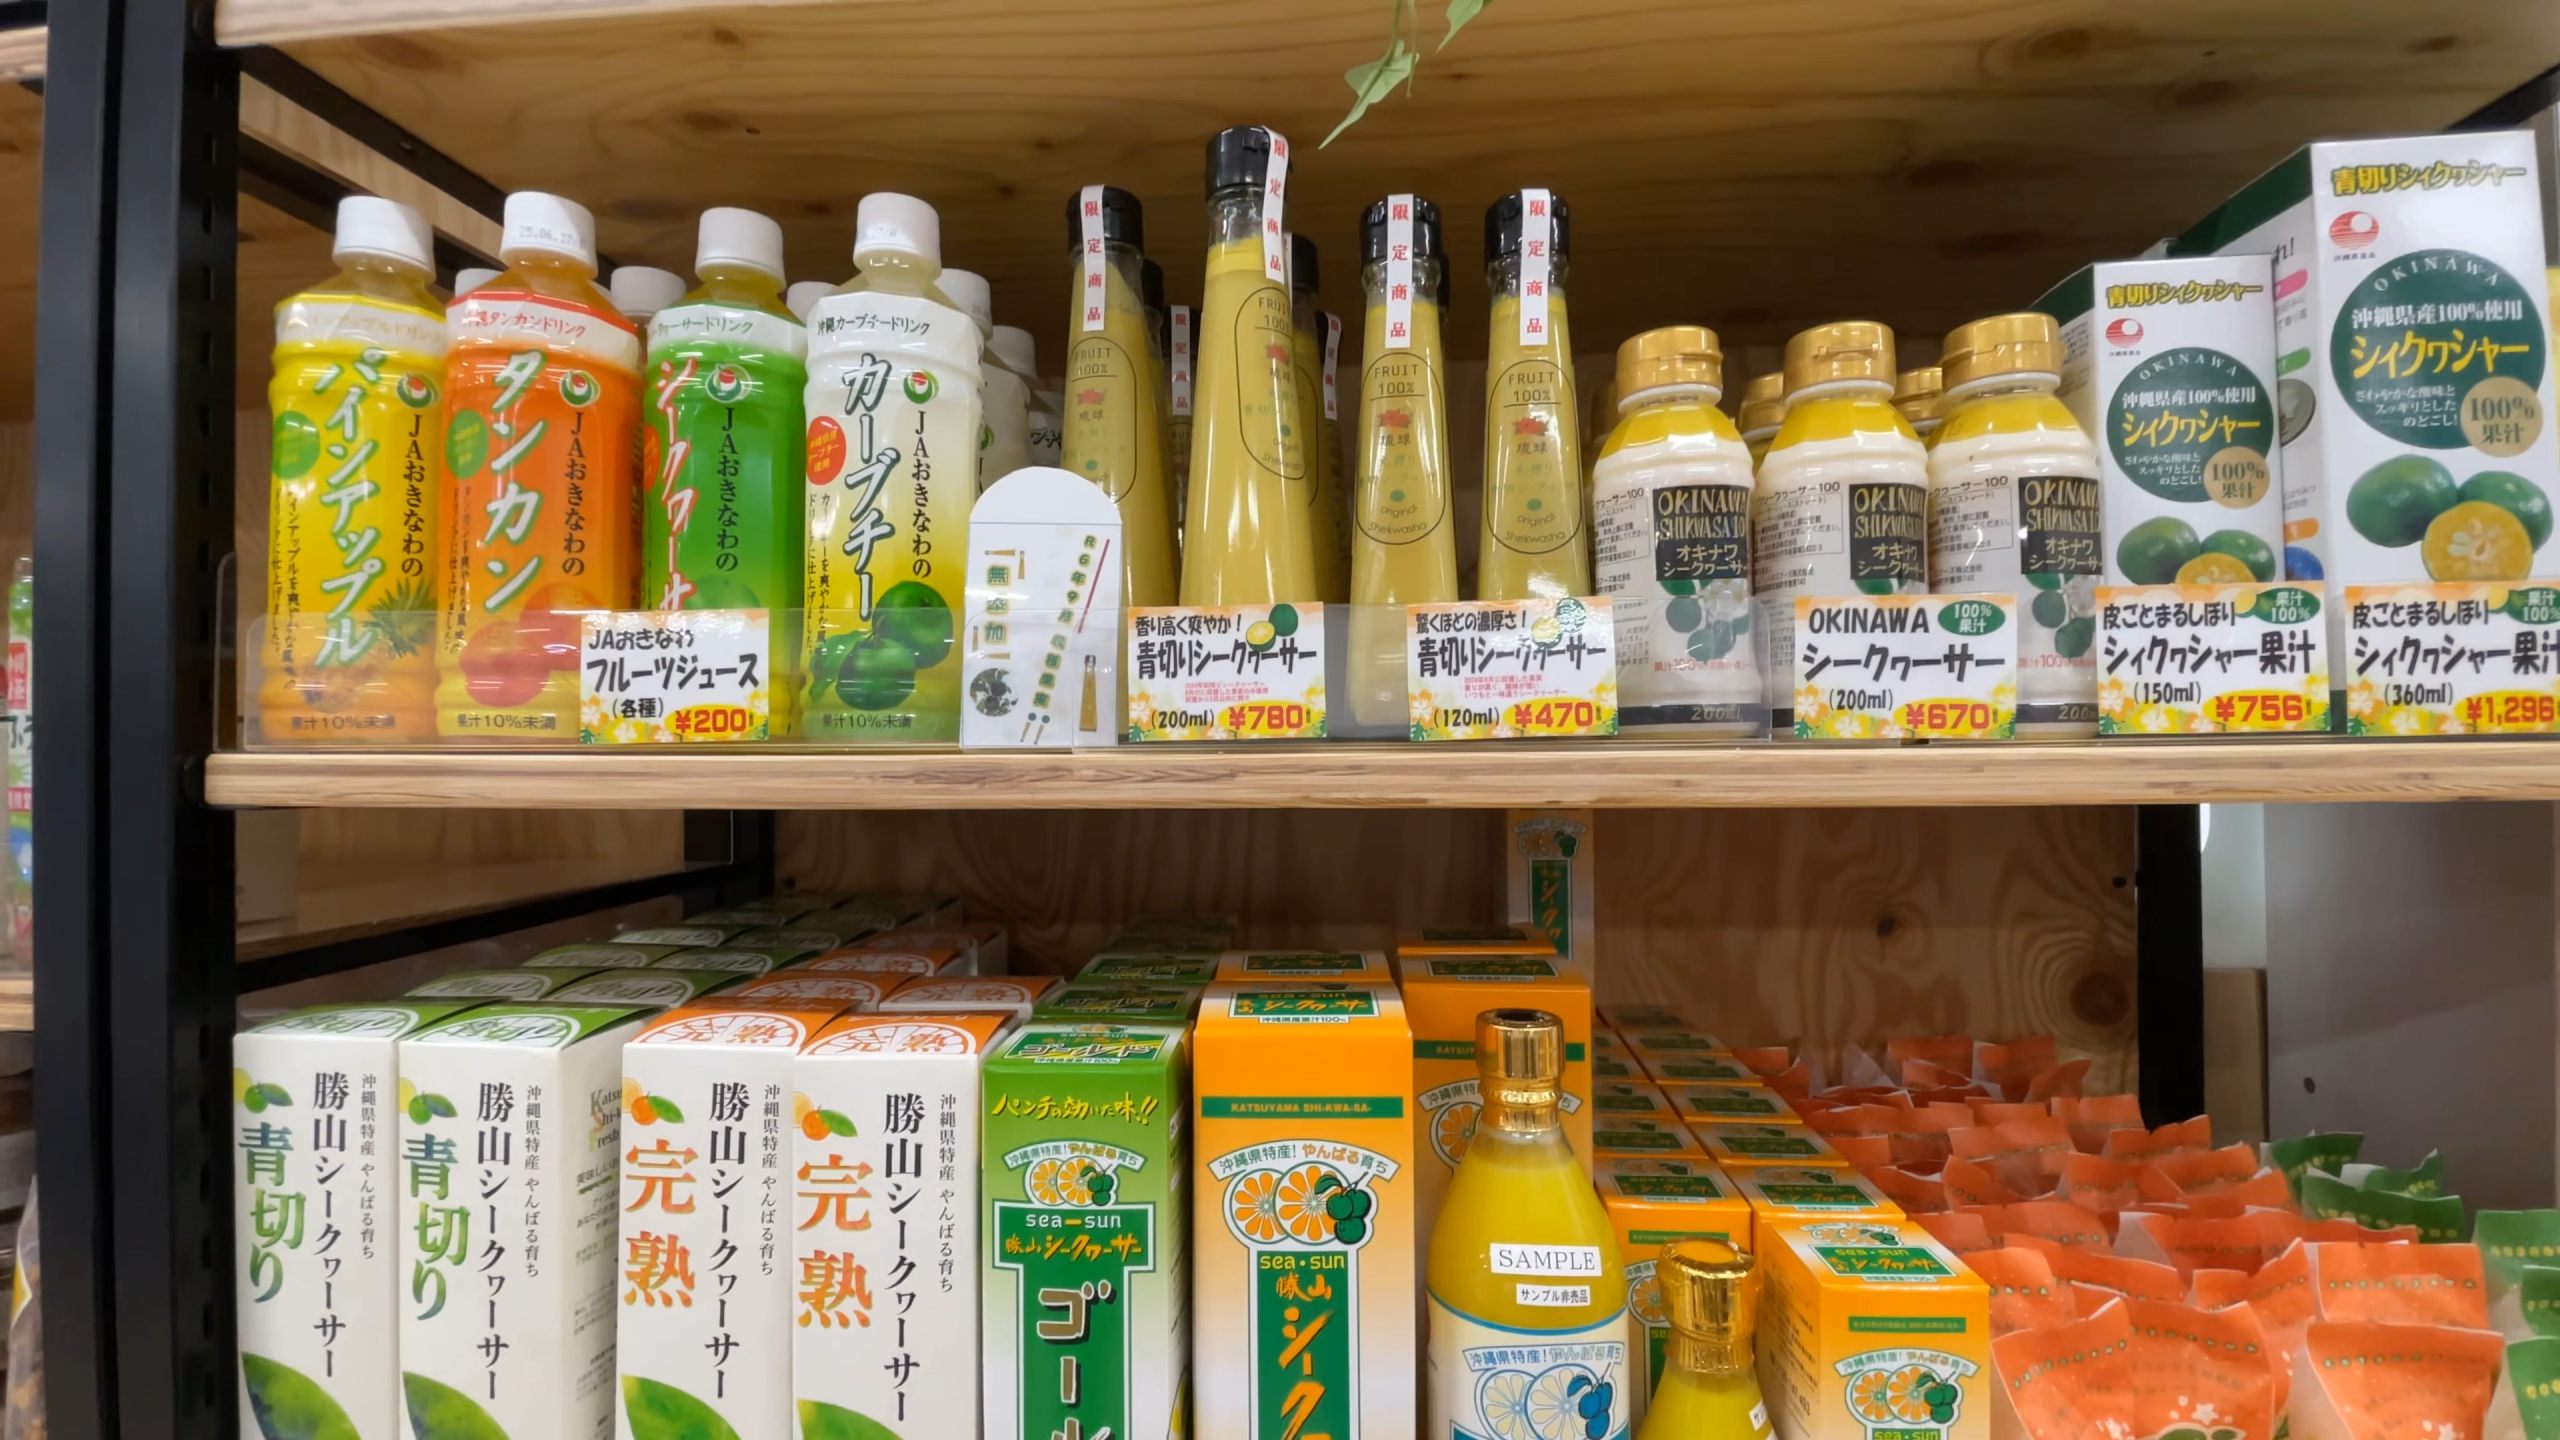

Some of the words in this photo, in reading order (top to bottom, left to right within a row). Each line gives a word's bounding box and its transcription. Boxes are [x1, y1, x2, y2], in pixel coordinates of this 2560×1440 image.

[1265, 138, 1288, 273] 限定商品
[1083, 200, 1103, 322] 限定商品
[1389, 203, 1409, 338] 限定商品
[1525, 199, 1547, 334] 限定商品
[2373, 255, 2501, 293] OKINAWA
[2351, 298, 2524, 330] 沖縄県産100%使用
[1374, 364, 1419, 379] FRUIT
[1508, 371, 1555, 386] FRUIT
[2138, 353, 2238, 383] OKINAWA
[1378, 381, 1414, 395] 100%
[1513, 389, 1551, 403] 100%
[2122, 386, 2257, 410] 沖縄県産100%使用
[2354, 383, 2457, 403] さわやかな酸味と
[2374, 399, 2458, 416] スッキリとした
[2469, 395, 2536, 423] 100%
[2481, 424, 2525, 446] 果汁
[2124, 451, 2202, 467] さわやかな酸味と
[2211, 461, 2266, 483] 100%
[401, 413, 426, 577] JAおきなわの
[484, 348, 548, 613] タンカン
[562, 410, 588, 577] JAおきなわの
[716, 406, 739, 573] JAおきなわの
[841, 352, 901, 622] カーブチー
[910, 410, 933, 579] JAおきなわの
[2221, 481, 2257, 500] 果汁
[314, 346, 388, 668] パインアップル
[1676, 543, 1739, 560] オキナワ
[2045, 539, 2094, 556] オキナワ
[986, 564, 1010, 645] 無添加
[1954, 603, 1993, 620] 100%
[2275, 590, 2305, 606] 果汁
[2527, 590, 2556, 606] 果汁
[1808, 606, 1931, 635] OKINAWA
[1957, 618, 1988, 634] 果汁
[2103, 601, 2237, 631] 皮ごとまるしぼり
[2270, 606, 2311, 623] 100%
[2352, 599, 2489, 630] 皮ごとまるしぼり
[588, 626, 695, 651] JAおきなわ
[586, 652, 760, 694] フルーツジュース
[1829, 688, 1894, 712] (200ml)
[2214, 694, 2304, 723] ¥756
[292, 713, 396, 731] 果汁10%未満
[457, 713, 556, 731] 果汁10%未満
[674, 709, 747, 735] ¥200
[821, 712, 912, 731] 果汁10%未満
[1228, 704, 1303, 731] ¥780
[1514, 701, 1594, 729] ¥470
[1904, 703, 1990, 730] ¥670
[360, 1073, 378, 1156] 沖縄県特産
[1231, 1103, 1300, 1113] KATSUYAMA
[524, 1084, 542, 1171] 沖縄県特産
[761, 1083, 781, 1170] 沖縄県特産
[938, 1093, 957, 1182] 沖縄県特産
[1218, 1143, 1298, 1175] 沖縄県特産!
[1301, 1142, 1390, 1175] やんばる育ち
[237, 1121, 307, 1305] 青切り
[359, 1162, 377, 1261] やんばる育ち
[624, 1137, 699, 1309] 完熟
[759, 1175, 777, 1277] やんばる育ち
[401, 1132, 472, 1322] 青切り
[523, 1176, 541, 1279] やんばる育ち
[797, 1153, 875, 1330] 完熟
[938, 1188, 956, 1293] やんばる育ち
[1498, 1248, 1596, 1271] SAMPLE
[1520, 1288, 1589, 1304] サンプル非売品
[1277, 1306, 1335, 1440] シーク
